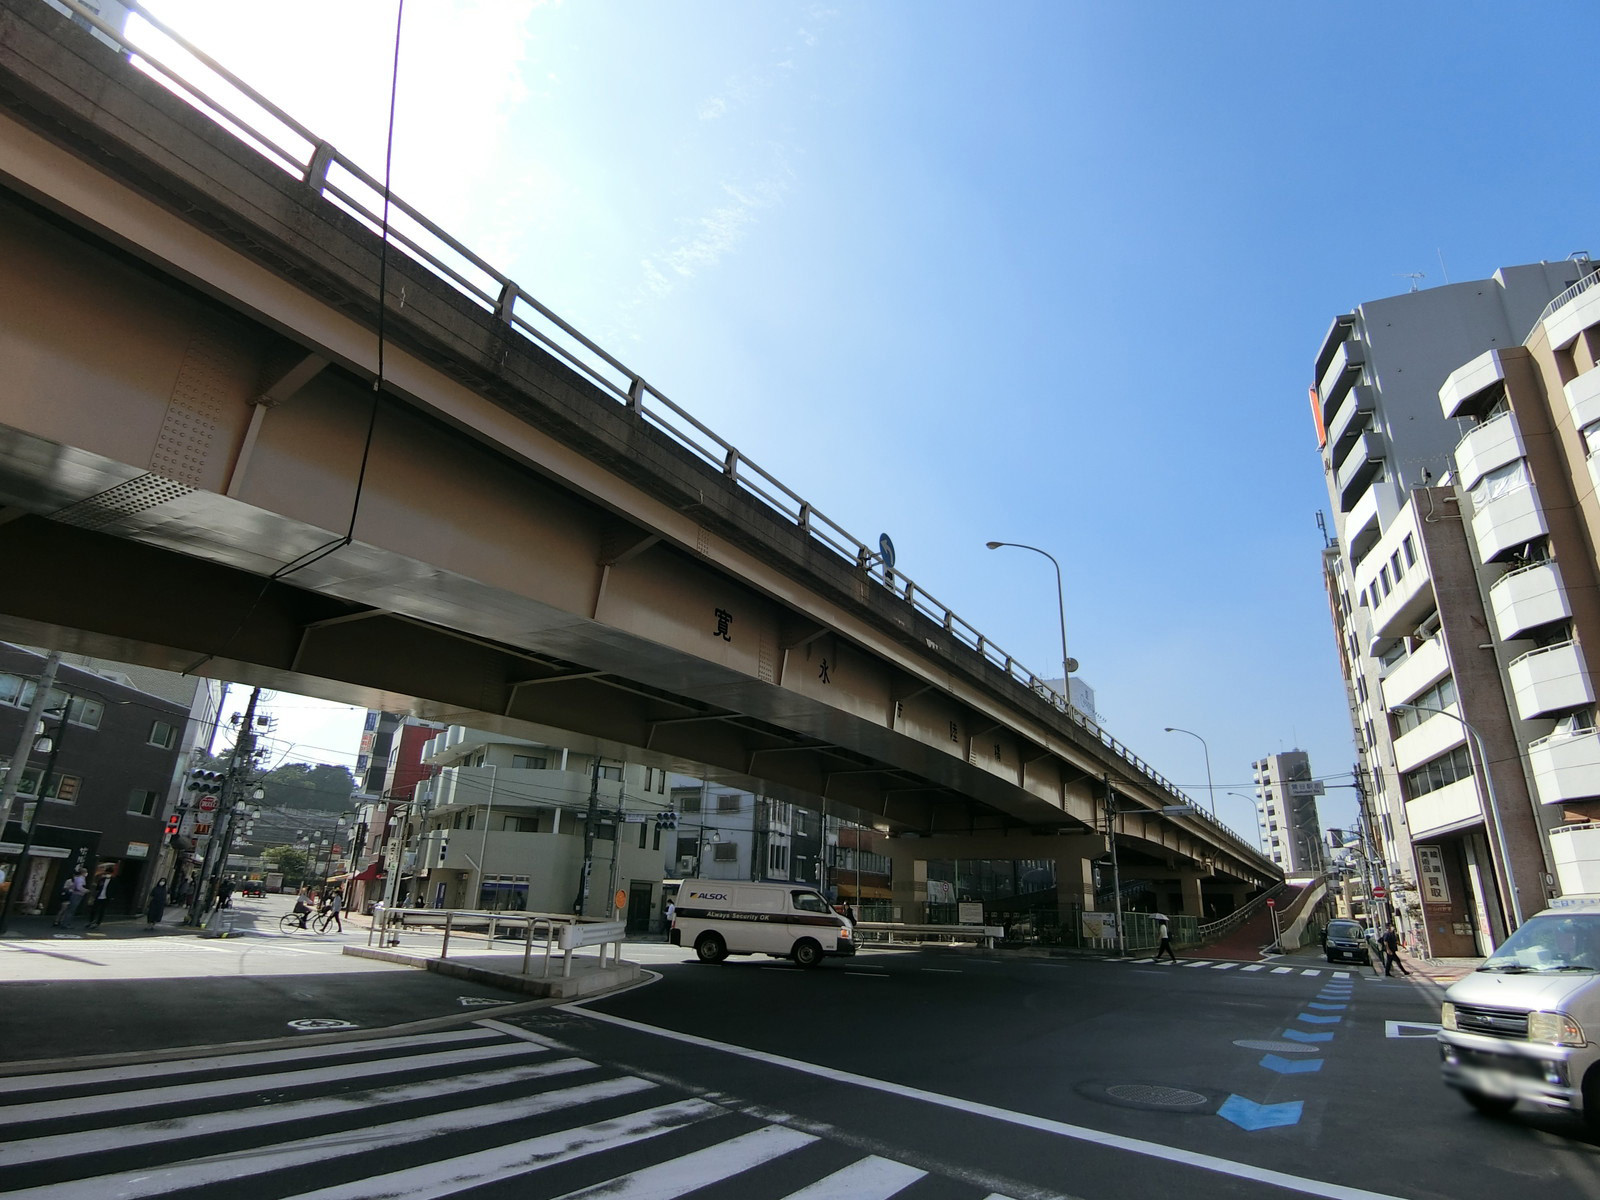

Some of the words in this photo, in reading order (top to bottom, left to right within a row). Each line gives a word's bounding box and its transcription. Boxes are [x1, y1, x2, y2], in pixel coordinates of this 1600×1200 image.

[1429, 877, 1442, 898] 買取
[698, 893, 727, 901] ALSOK
[732, 913, 758, 921] Security
